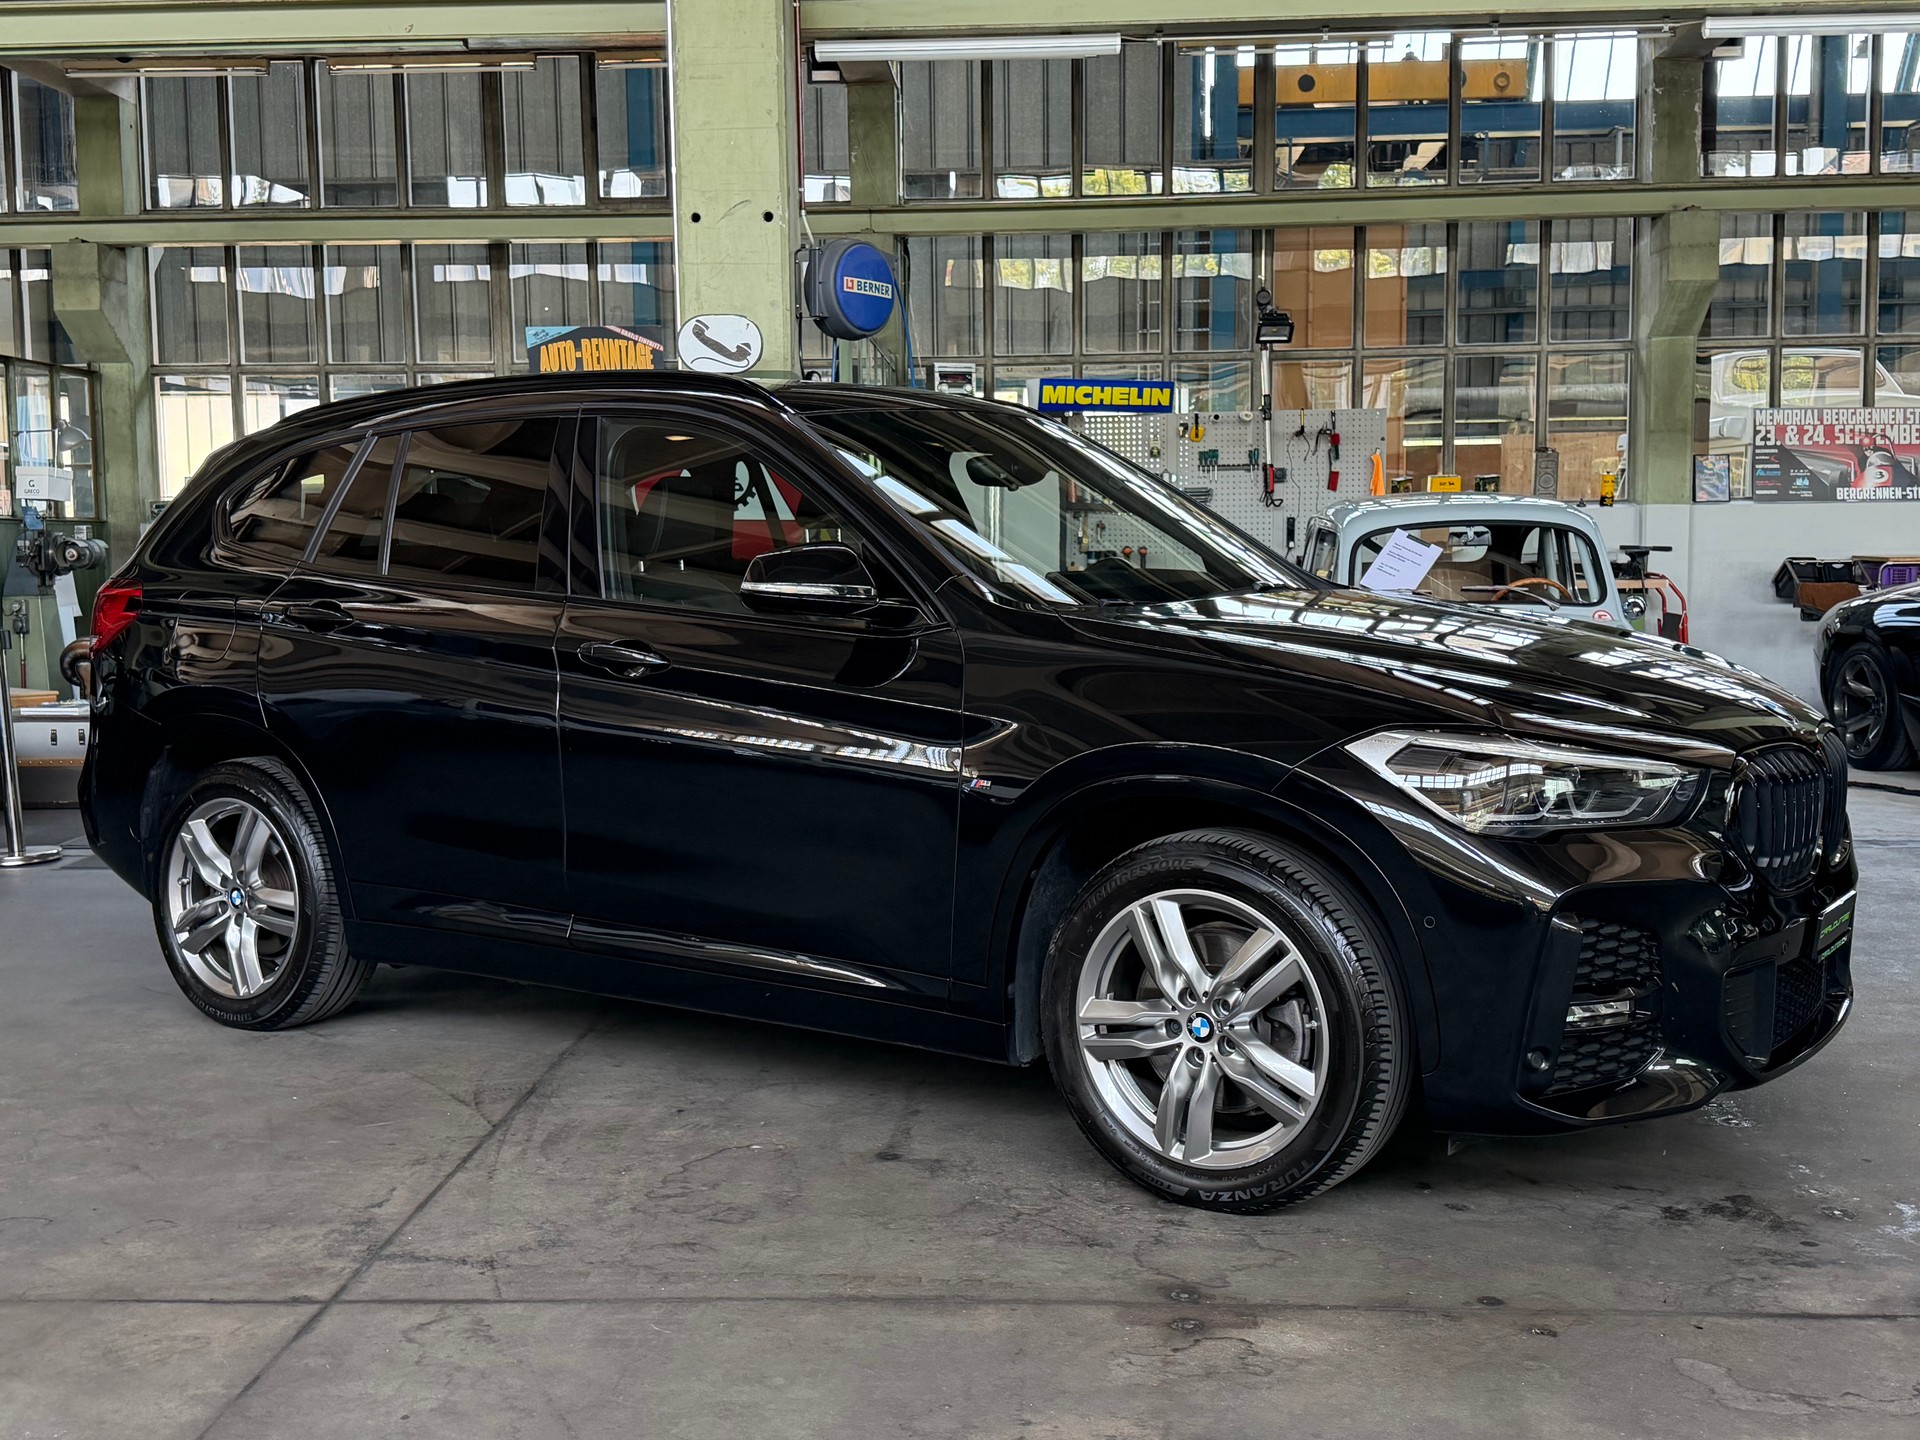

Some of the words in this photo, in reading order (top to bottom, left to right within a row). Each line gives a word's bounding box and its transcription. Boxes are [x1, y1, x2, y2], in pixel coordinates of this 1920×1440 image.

[857, 280, 890, 297] BERNER
[540, 337, 655, 372] AUTO-RENNTAGE
[1041, 385, 1171, 406] MICHELIN
[1755, 408, 1821, 426] MEMORIAL
[1823, 408, 1905, 425] BERGRENNEN
[1755, 425, 1782, 446] 23.
[1784, 425, 1800, 446] &
[1803, 425, 1831, 446] 24.
[1199, 1158, 1316, 1202] TURANZA
